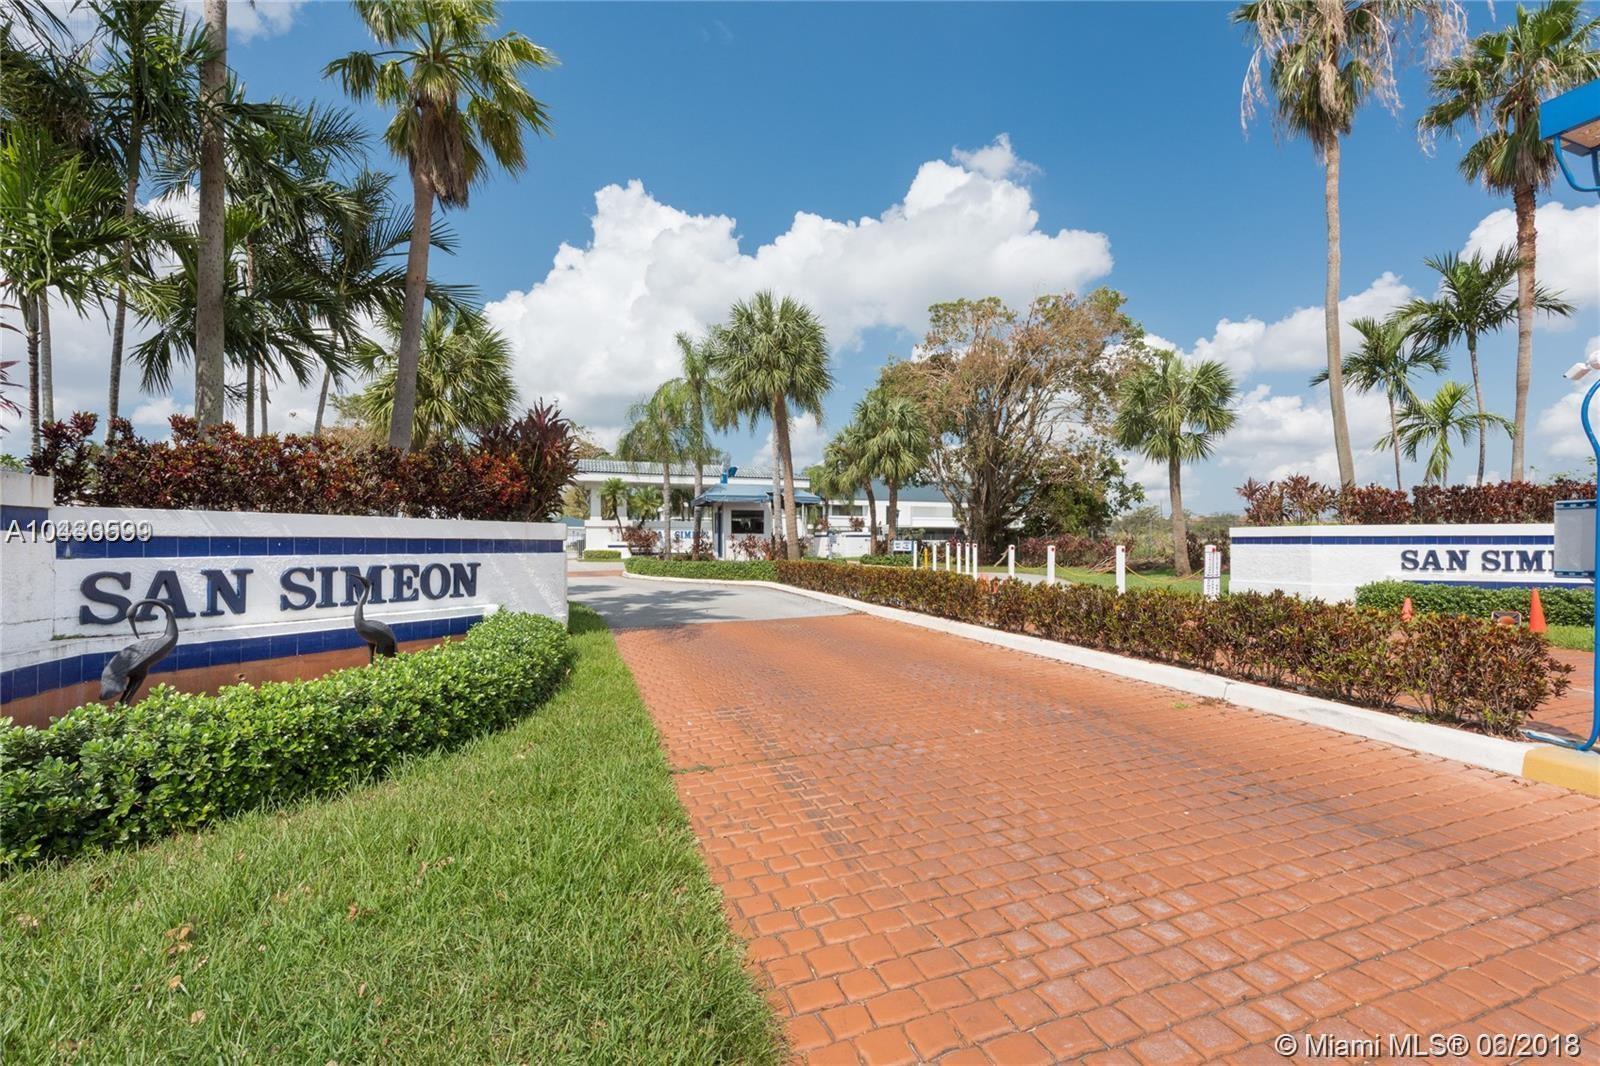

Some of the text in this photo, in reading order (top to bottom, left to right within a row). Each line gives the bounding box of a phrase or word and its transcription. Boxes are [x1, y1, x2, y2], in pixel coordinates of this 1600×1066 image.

[1400, 549, 1470, 571] SAN
[79, 562, 481, 625] SAN SIMEON
